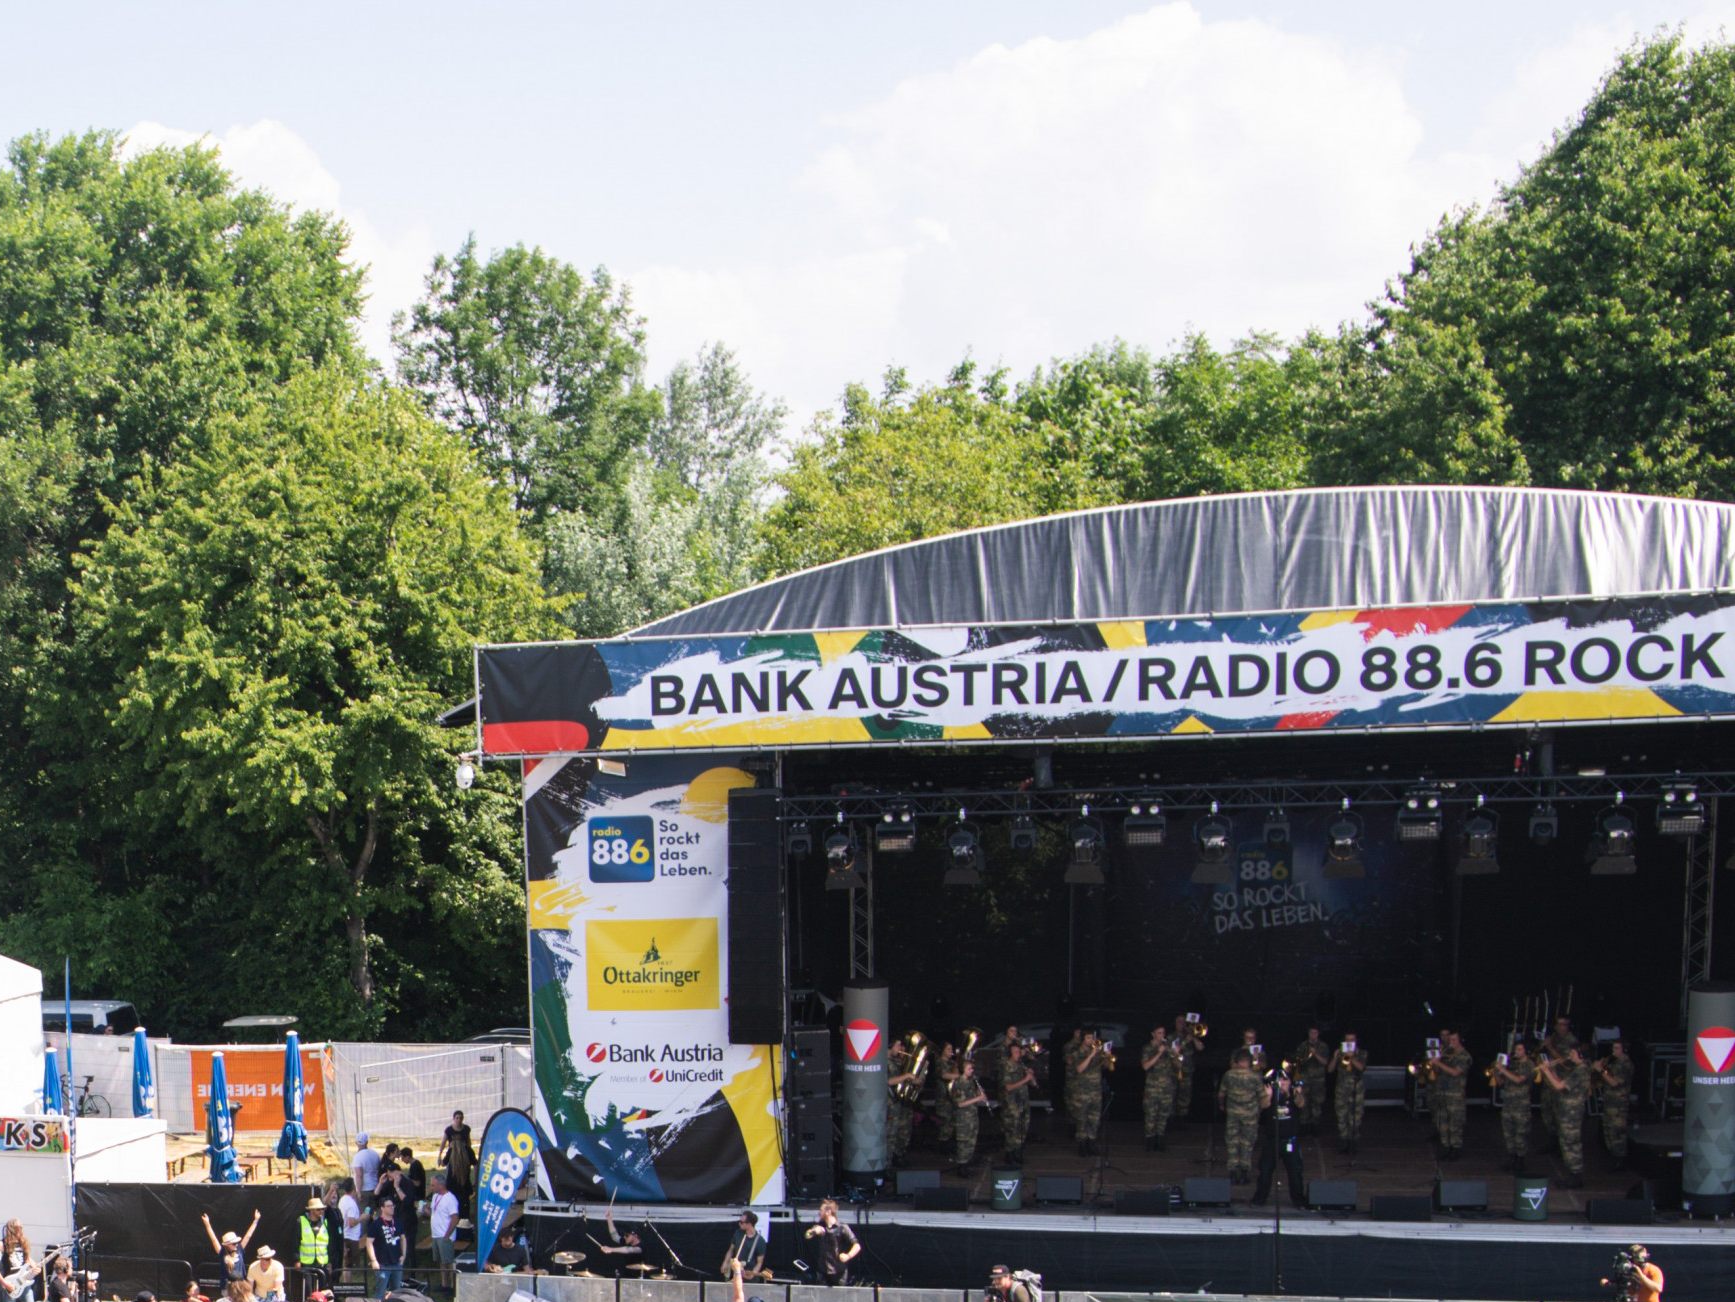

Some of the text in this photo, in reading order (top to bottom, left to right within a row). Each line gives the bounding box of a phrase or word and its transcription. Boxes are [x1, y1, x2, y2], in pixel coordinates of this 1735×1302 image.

[650, 668, 813, 716] BANK
[1360, 642, 1504, 692] 88.6
[1524, 632, 1725, 686] ROCK
[592, 827, 622, 837] radio
[659, 820, 679, 833] So
[659, 832, 701, 846] rockt
[592, 838, 650, 865] 886
[659, 848, 689, 860] das
[660, 864, 713, 877] Leben.
[1240, 860, 1288, 881] 886
[1213, 880, 1309, 911] SO ROCKT
[1215, 903, 1329, 934] DAS LEBEN.
[603, 966, 701, 987] Ottakringer
[609, 1044, 724, 1063] Bank Austria
[666, 1069, 724, 1083] UniCredit
[1693, 1076, 1735, 1085] UNSER HEE
[480, 1153, 495, 1187] radio
[490, 1130, 533, 1200] 886
